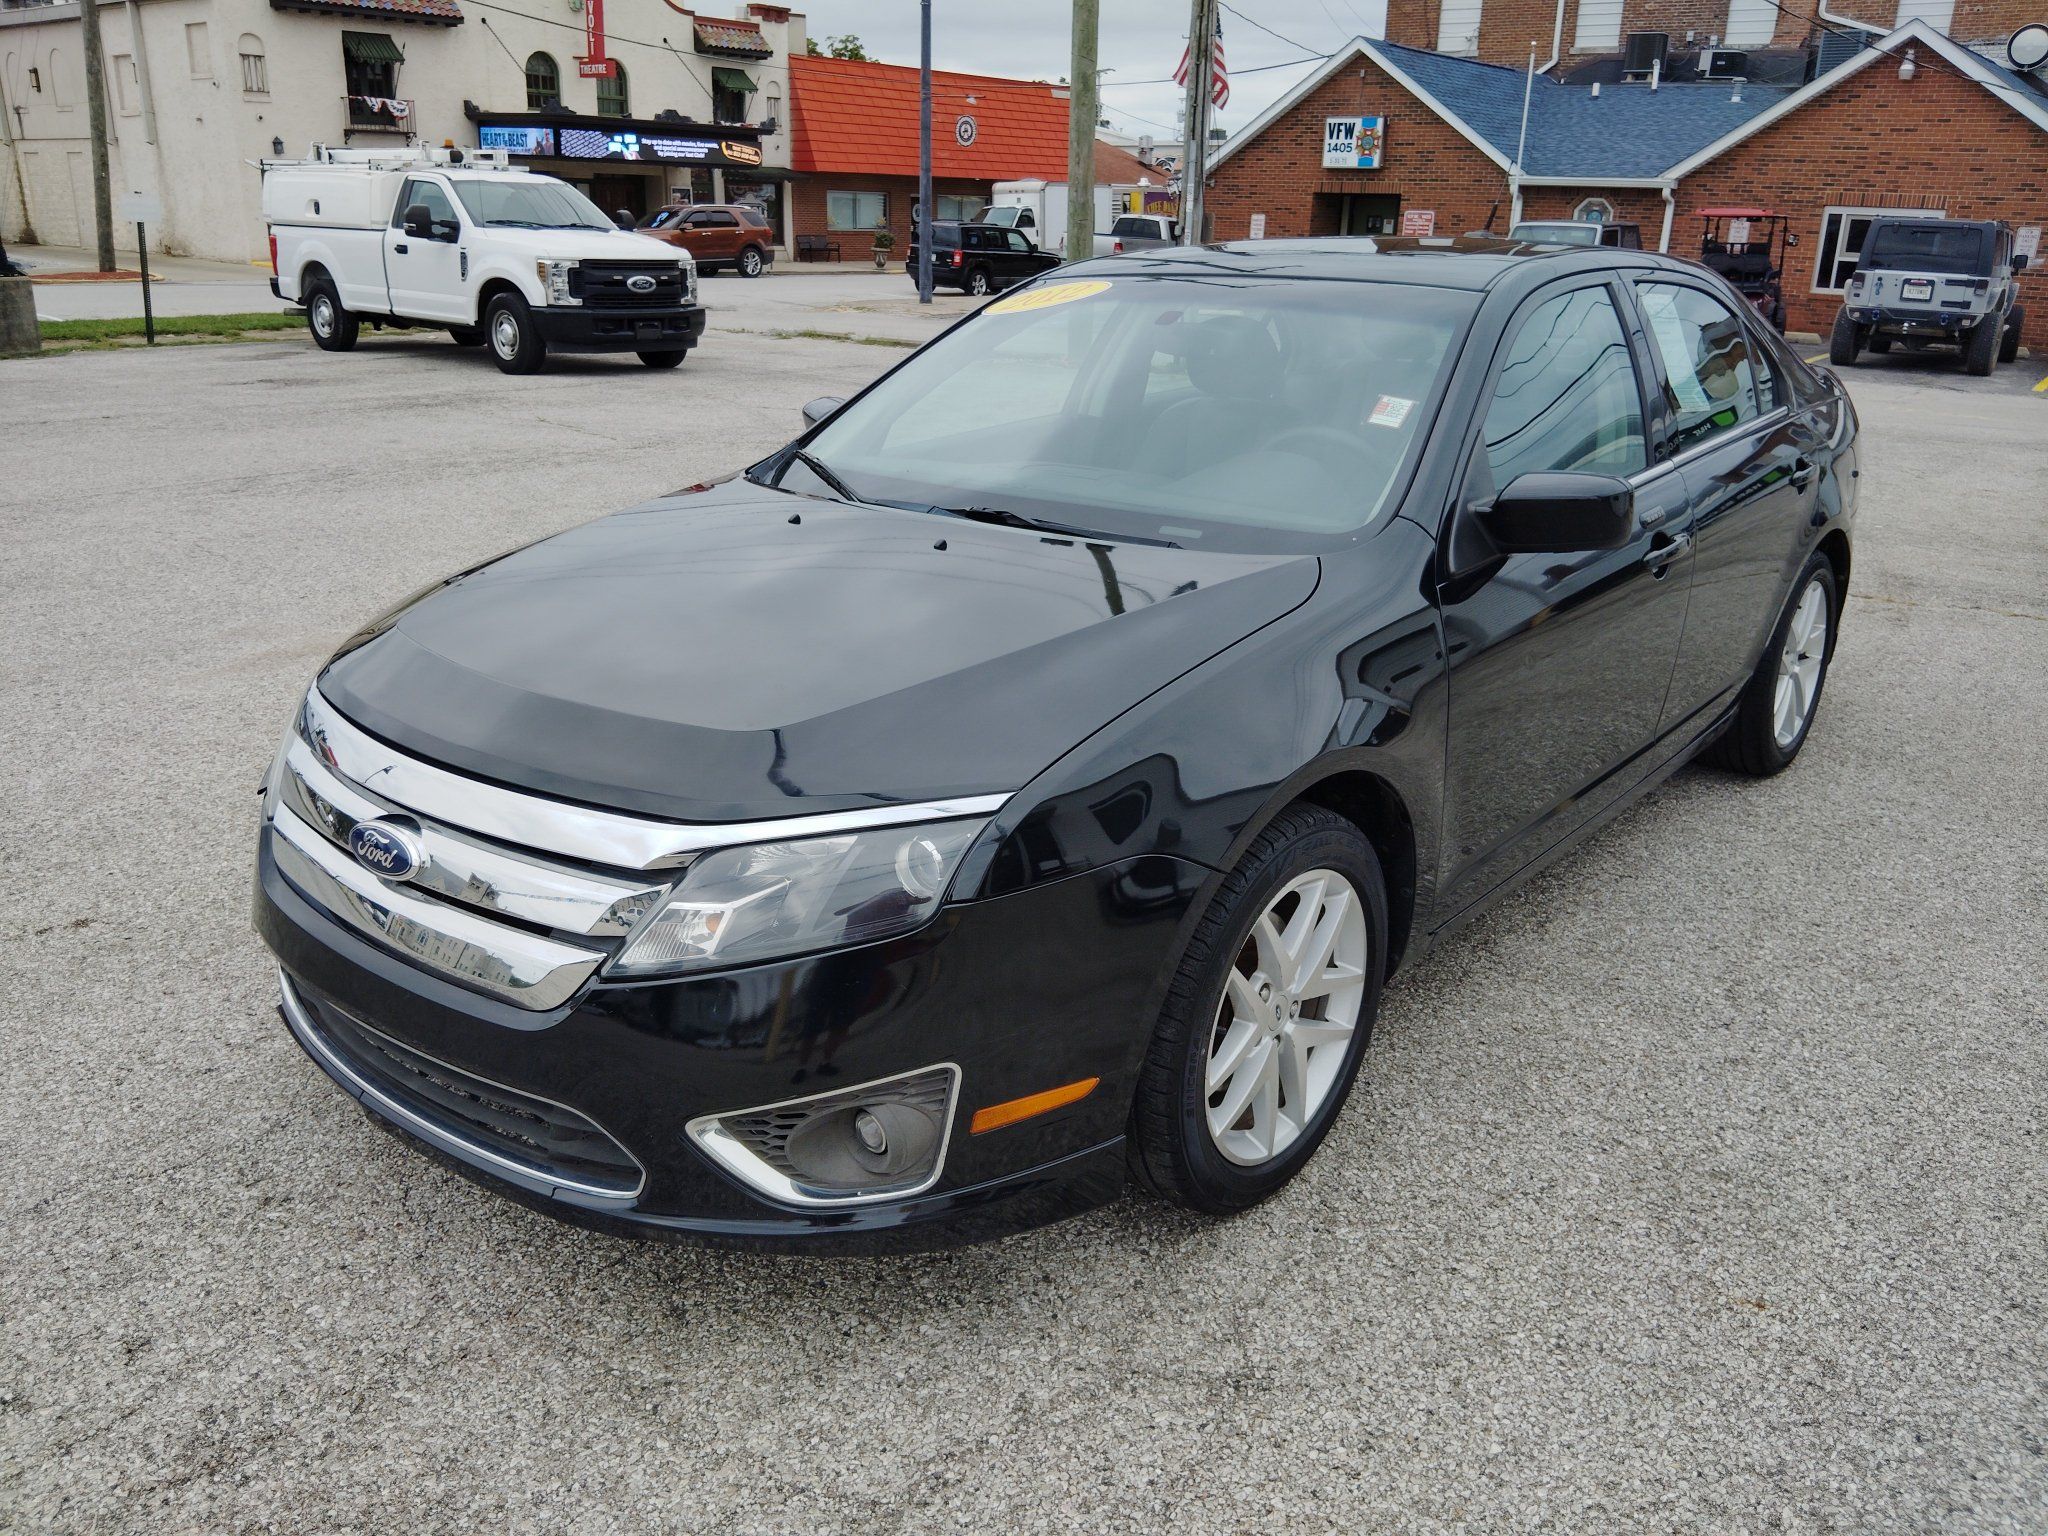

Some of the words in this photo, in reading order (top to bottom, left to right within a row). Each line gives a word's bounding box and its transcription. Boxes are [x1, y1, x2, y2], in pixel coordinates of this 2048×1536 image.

[580, 64, 607, 74] THEATRE
[1328, 122, 1356, 140] VFW
[481, 132, 501, 147] HEART
[508, 133, 528, 147] BEAST
[1327, 142, 1353, 153] 1405
[358, 830, 398, 868] Ford
